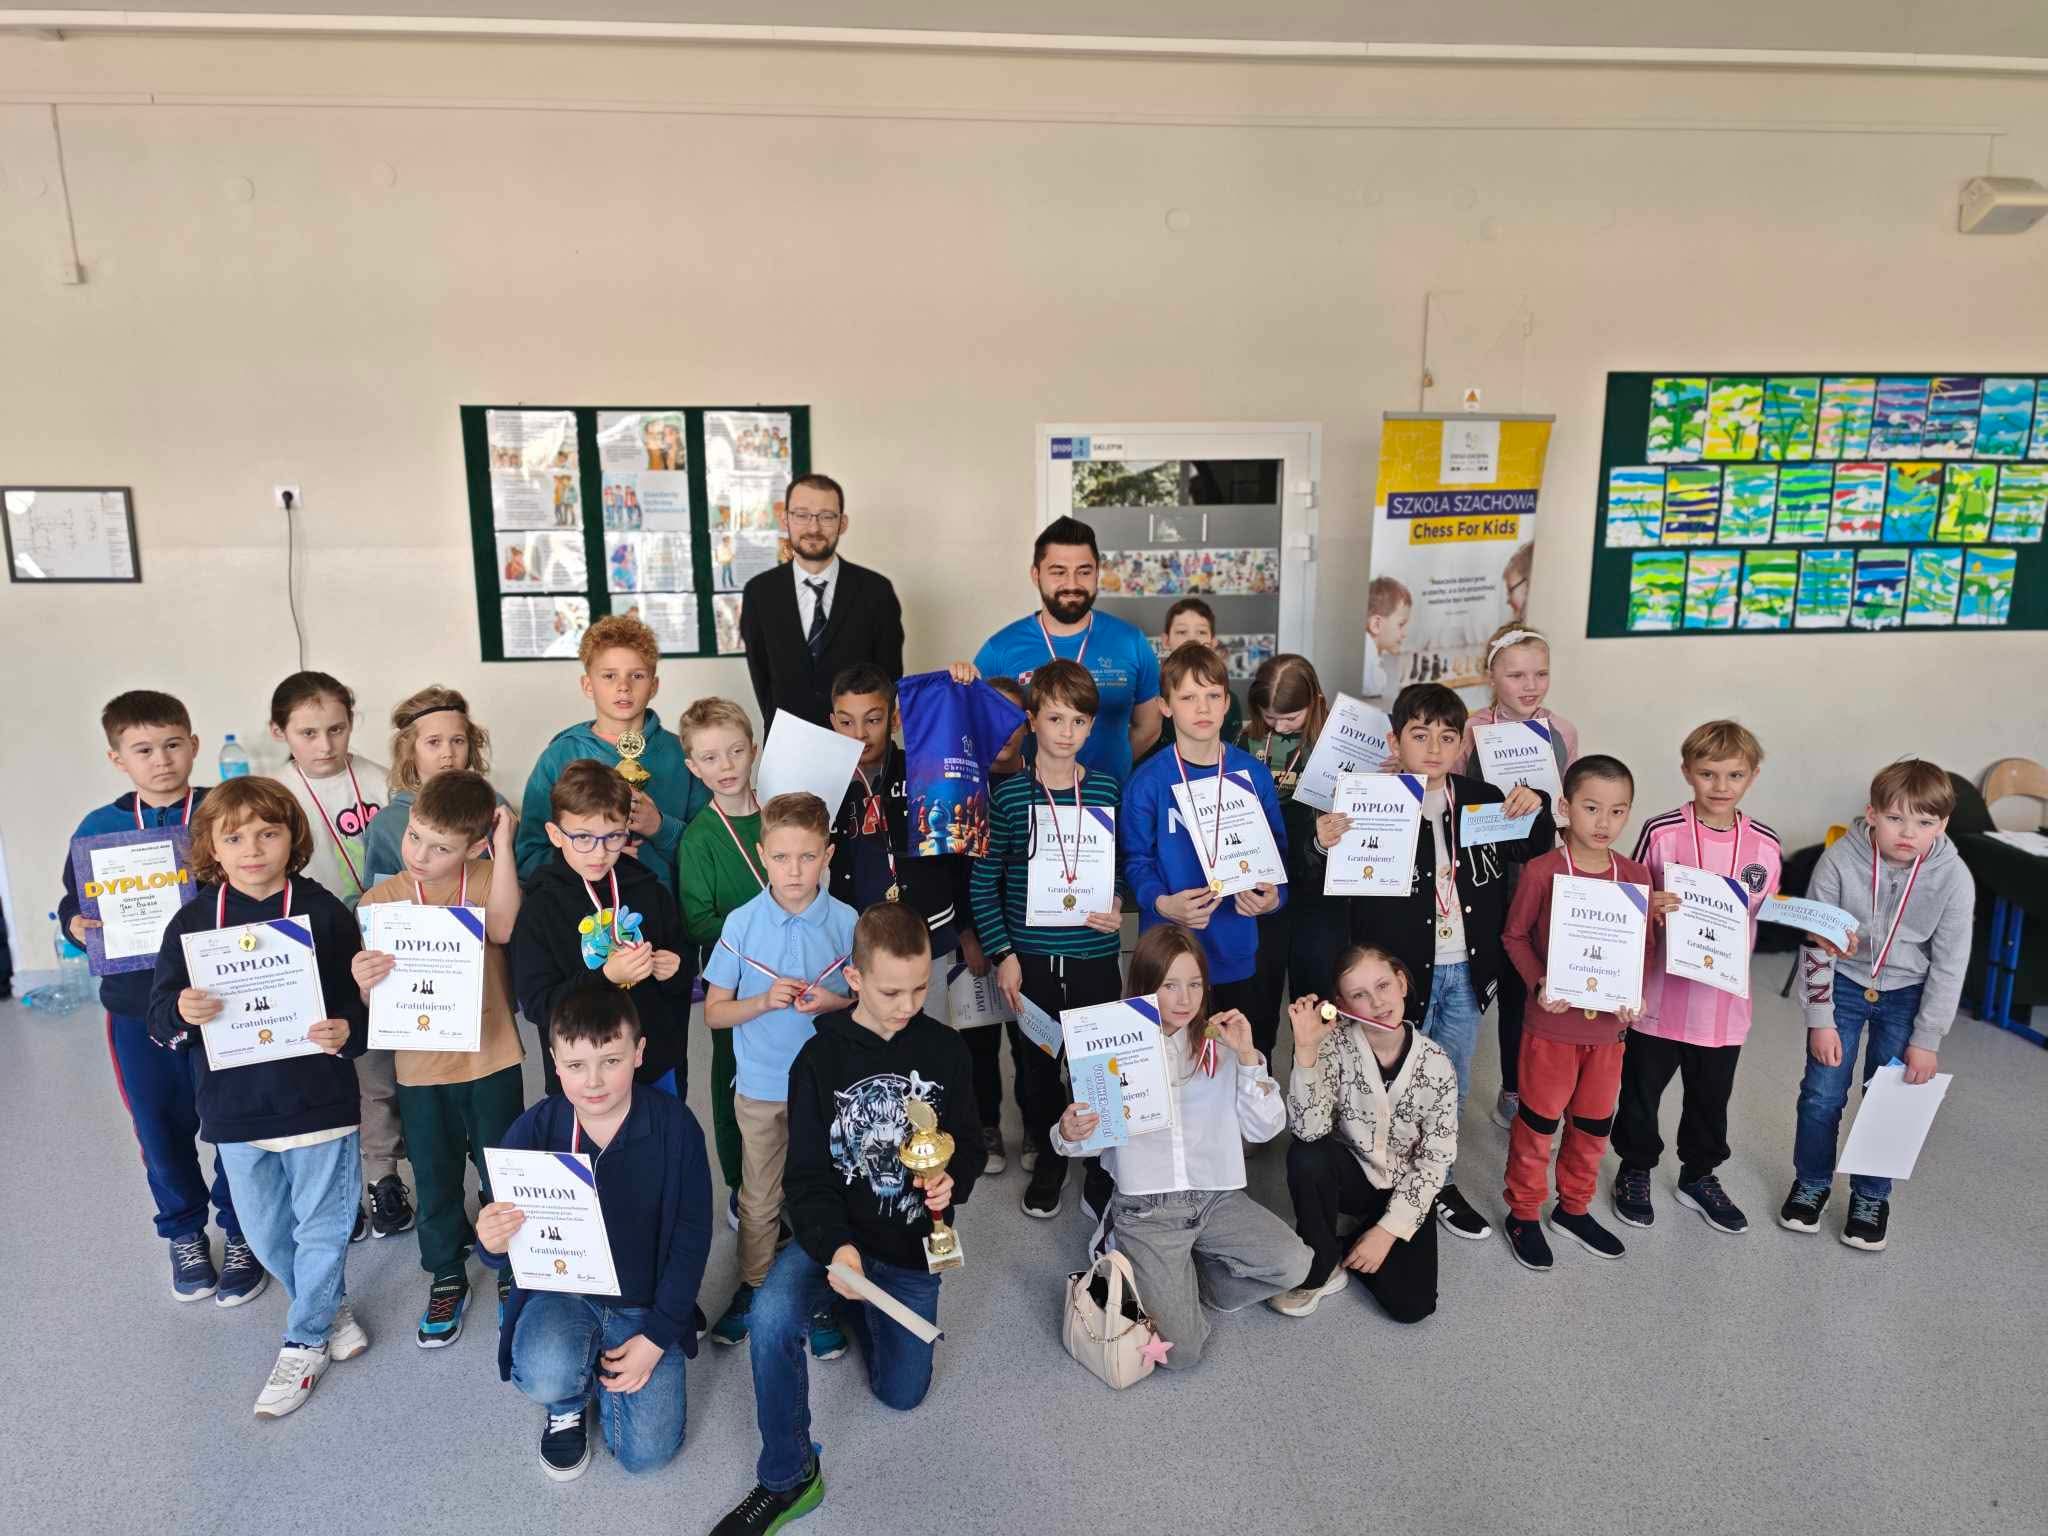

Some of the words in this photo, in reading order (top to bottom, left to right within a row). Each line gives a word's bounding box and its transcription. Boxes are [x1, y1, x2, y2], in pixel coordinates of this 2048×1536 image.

[1393, 496, 1450, 514] SZKOŁA
[1453, 494, 1537, 513] SZACHOWA
[1413, 522, 1453, 539] Chess
[1457, 521, 1480, 536] For
[1482, 519, 1516, 535] Kids
[1340, 723, 1385, 750] DYPLOM
[1494, 745, 1539, 760] DYPLOM
[1198, 799, 1245, 817] DYLOM
[1351, 802, 1404, 814] DYPLOM
[84, 868, 189, 898] DYPLOM
[1684, 891, 1734, 914] DYPLOM
[1571, 907, 1627, 924] DYPLOM
[395, 939, 460, 953] DYPLOM
[216, 953, 290, 976] DYPLOM
[1805, 951, 1831, 1004] NY
[231, 1012, 297, 1030] Gratulujemy!
[1086, 1031, 1144, 1052] DYPLOM
[513, 1186, 577, 1201] DYPLOM
[530, 1246, 587, 1258] Gratulujemy!
